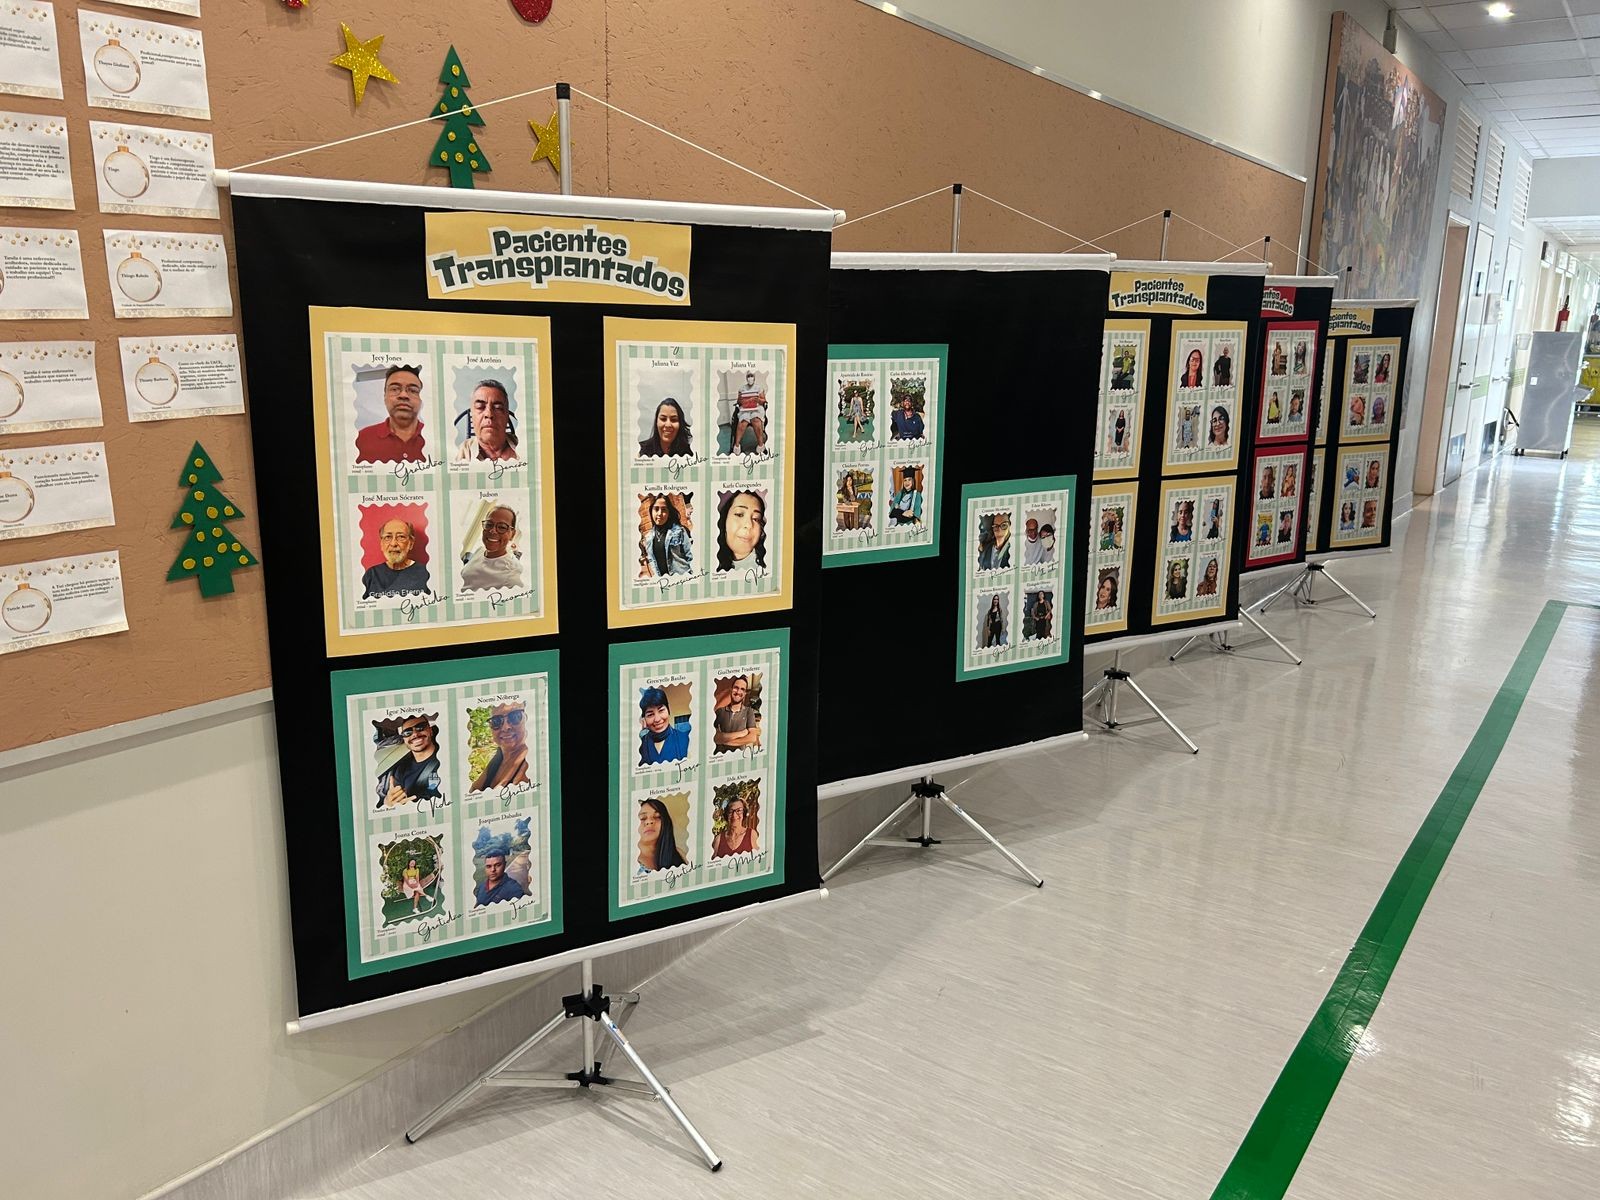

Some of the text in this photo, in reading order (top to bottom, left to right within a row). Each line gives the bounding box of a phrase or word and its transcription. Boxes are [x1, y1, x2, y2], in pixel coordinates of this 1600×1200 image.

[493, 228, 626, 256] Pacientes
[433, 254, 684, 298] Transplantados
[1135, 278, 1184, 292] Pacientes
[1112, 290, 1204, 311] Transplantados
[1263, 300, 1293, 314] antados
[1329, 312, 1357, 321] cientes
[1329, 321, 1371, 332] splantados
[386, 354, 402, 363] Jones
[467, 356, 478, 364] José
[362, 495, 375, 503] José
[386, 709, 399, 717] Igor
[395, 832, 410, 840] Joana
